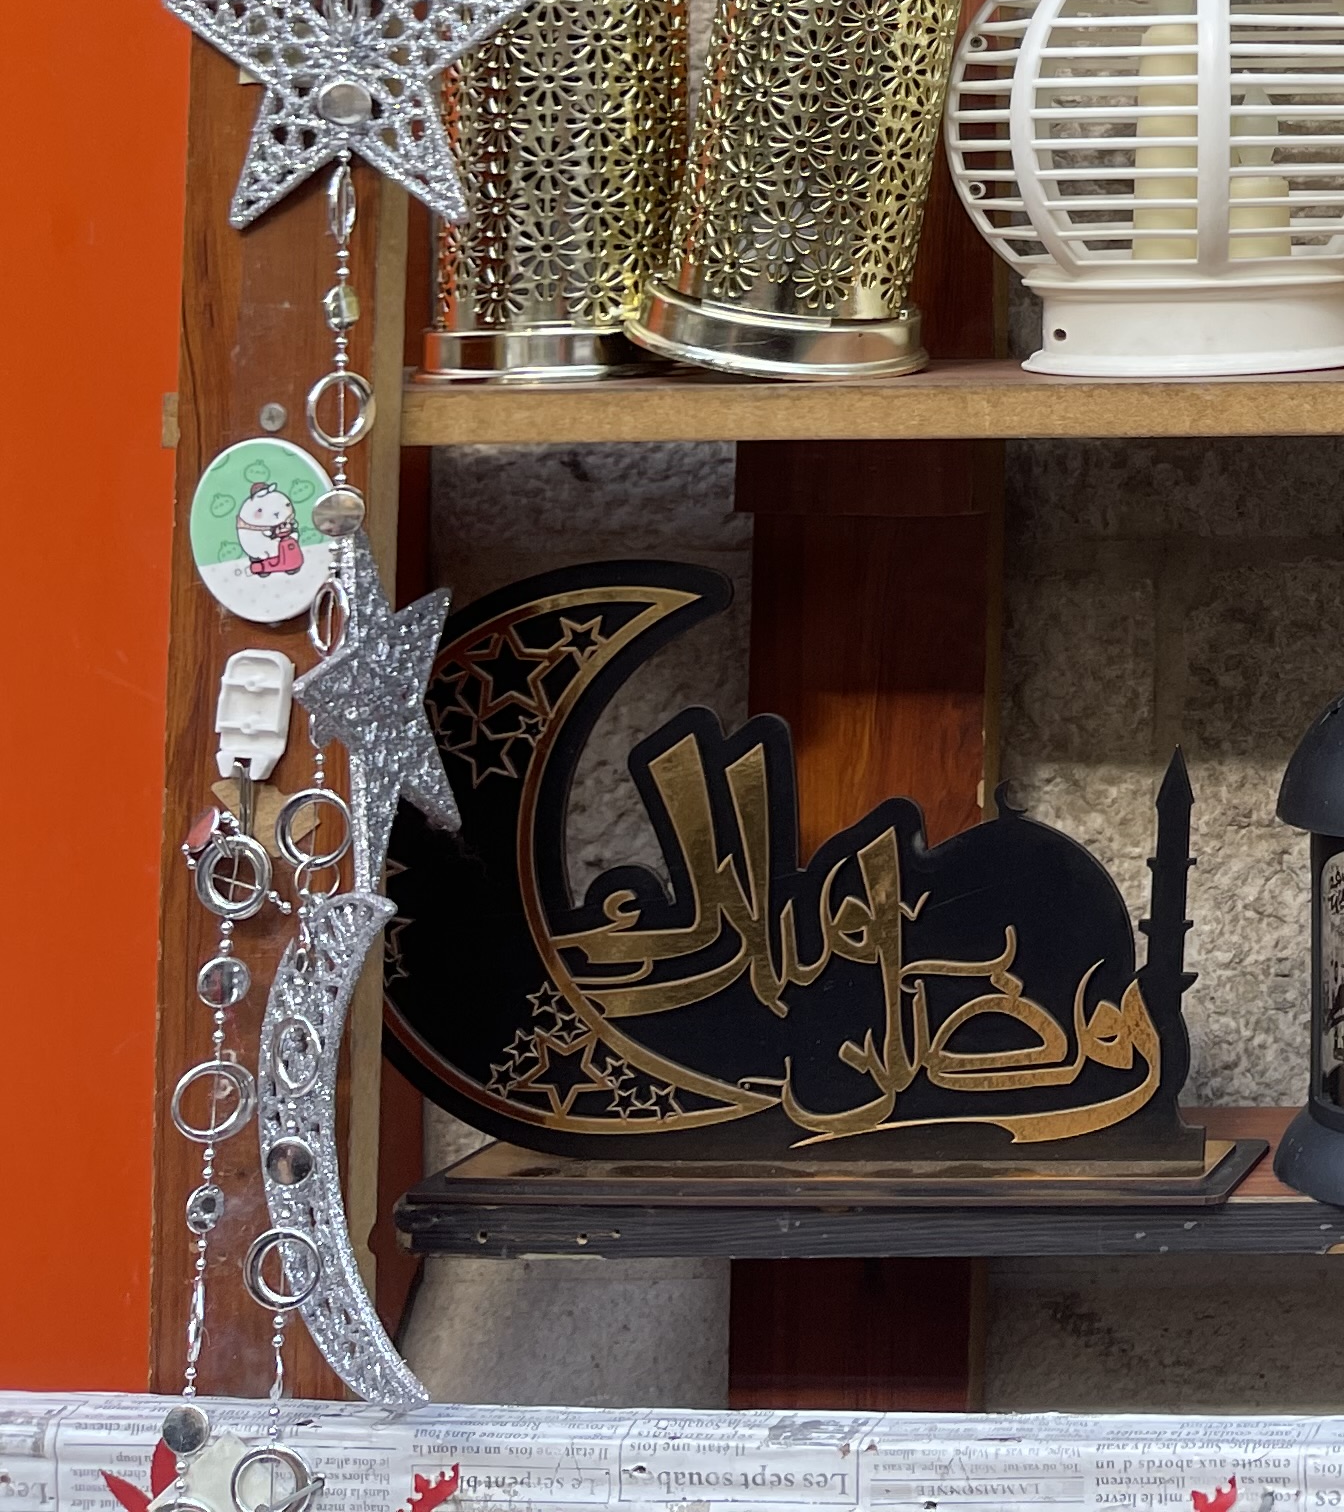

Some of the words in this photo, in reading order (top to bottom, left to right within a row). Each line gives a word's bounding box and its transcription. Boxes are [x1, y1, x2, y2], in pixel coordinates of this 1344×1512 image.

[739, 829, 1161, 1148] رمضان
[443, 1430, 476, 1439] dans
[412, 1444, 423, 1455] la
[425, 1444, 458, 1456] dont
[462, 1445, 479, 1454] roi
[484, 1446, 501, 1454] un
[504, 1445, 532, 1459] fois,
[630, 1442, 657, 1455] fois
[662, 1443, 690, 1452] une
[696, 1443, 730, 1456] était
[735, 1443, 745, 1456] Il
[1006, 1447, 1022, 1456] vas
[1028, 1447, 1040, 1458] tu
[1096, 1442, 1128, 1454] avait
[1142, 1442, 1152, 1454] il
[1181, 1442, 1195, 1452] ce
[1198, 1442, 1222, 1454] Sur
[116, 1452, 141, 1464] loup
[566, 1446, 594, 1460] était
[599, 1448, 608, 1460] Il
[324, 1458, 350, 1468] aller
[353, 1458, 376, 1468] dois
[380, 1456, 389, 1468] je
[905, 1462, 916, 1473] Je
[1060, 1462, 1079, 1472] Toi,
[1139, 1459, 1193, 1471] abords
[1199, 1458, 1226, 1469] aux
[1232, 1458, 1290, 1471] ensuite
[882, 1464, 902, 1473] vais
[1313, 1462, 1342, 1478] fois
[116, 1470, 147, 1479] chers
[342, 1473, 370, 1483] alors
[739, 1464, 795, 1490] sept
[1241, 1476, 1254, 1484] sa
[486, 1472, 564, 1489] serpent
[803, 1473, 849, 1495] Les
[1095, 1476, 1165, 1487] arrivèrent
[1169, 1476, 1185, 1486] Ils
[1258, 1476, 1290, 1486] dans
[572, 1478, 595, 1495] Le
[1019, 1483, 1039, 1495] LA
[351, 1488, 360, 1499] la
[364, 1488, 389, 1499] dans
[71, 1499, 95, 1509] aller
[1095, 1494, 1137, 1508] lièvre
[1140, 1493, 1154, 1506] le
[316, 1504, 345, 1512] mère
[349, 1502, 389, 1512] chaque
